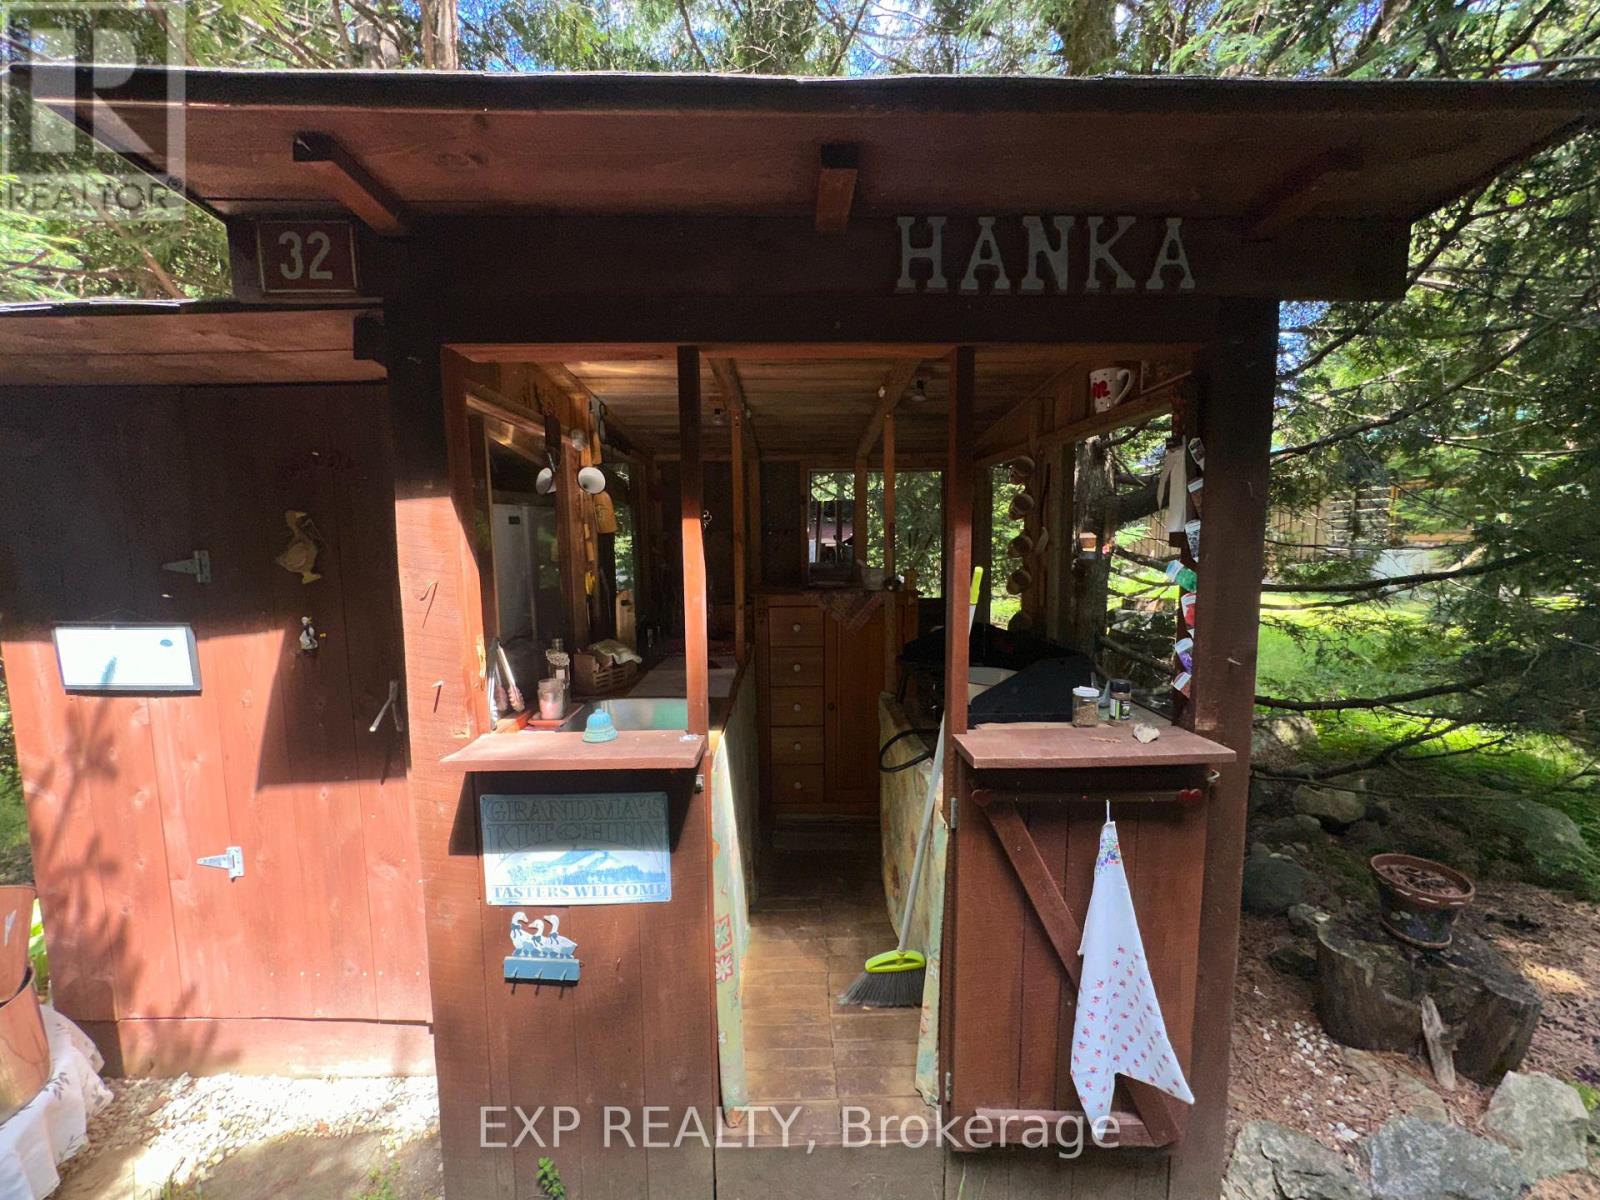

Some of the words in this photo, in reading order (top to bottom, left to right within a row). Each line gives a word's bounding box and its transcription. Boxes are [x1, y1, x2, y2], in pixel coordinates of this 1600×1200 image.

[277, 230, 333, 280] 32
[897, 216, 1196, 290] HANKA
[487, 798, 666, 821] GRANDMA'S
[488, 822, 665, 866] KITCHEN
[494, 886, 570, 899] TASTERS
[573, 884, 666, 898] WELCOME
